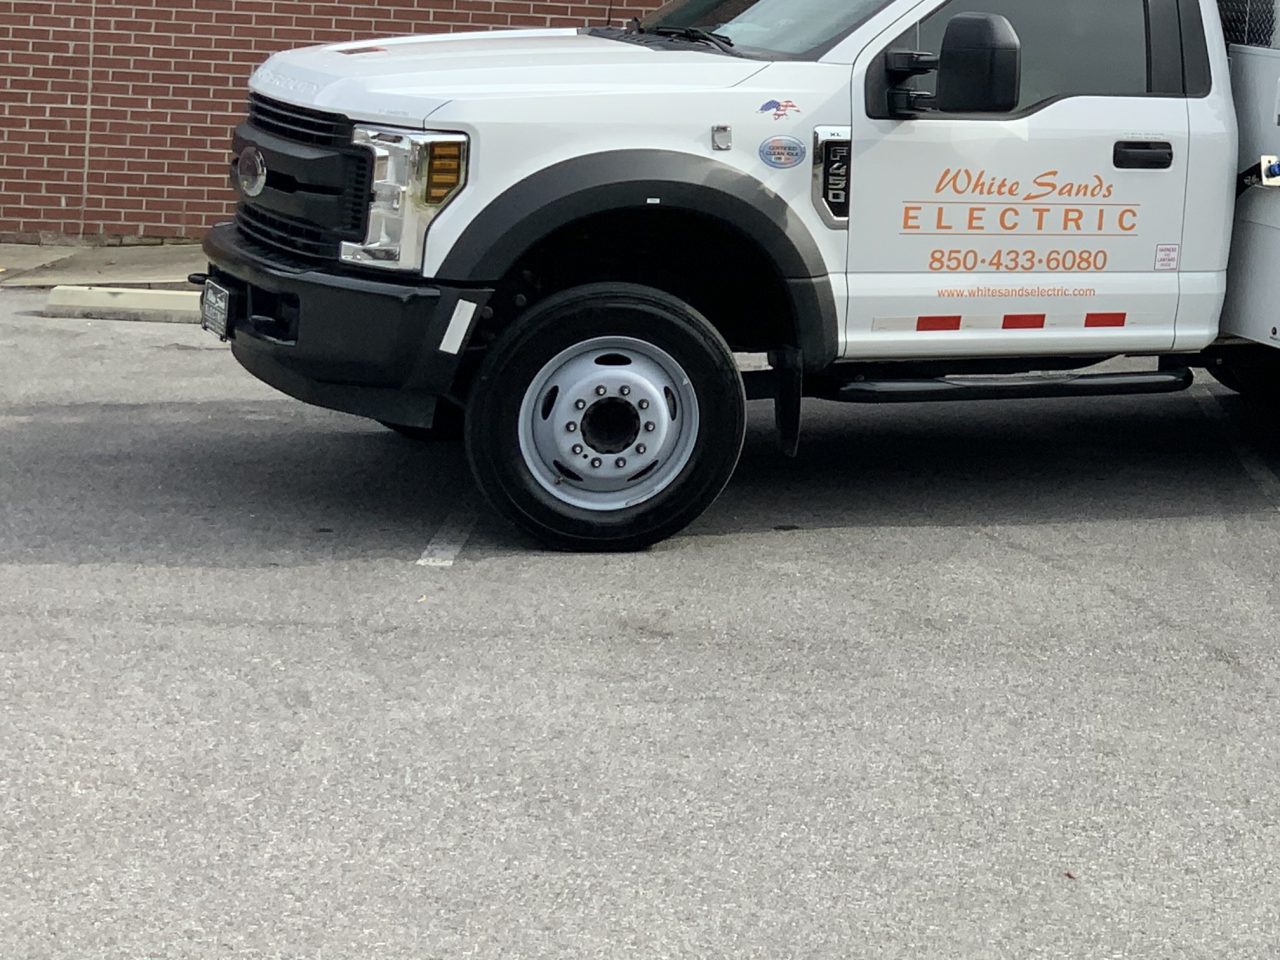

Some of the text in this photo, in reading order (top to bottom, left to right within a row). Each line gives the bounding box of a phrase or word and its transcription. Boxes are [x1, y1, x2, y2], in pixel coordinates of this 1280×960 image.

[935, 168, 1113, 201] White Sands
[902, 206, 1138, 231] ELECTRIC
[937, 286, 1096, 298] www.whitesandselectric.com
